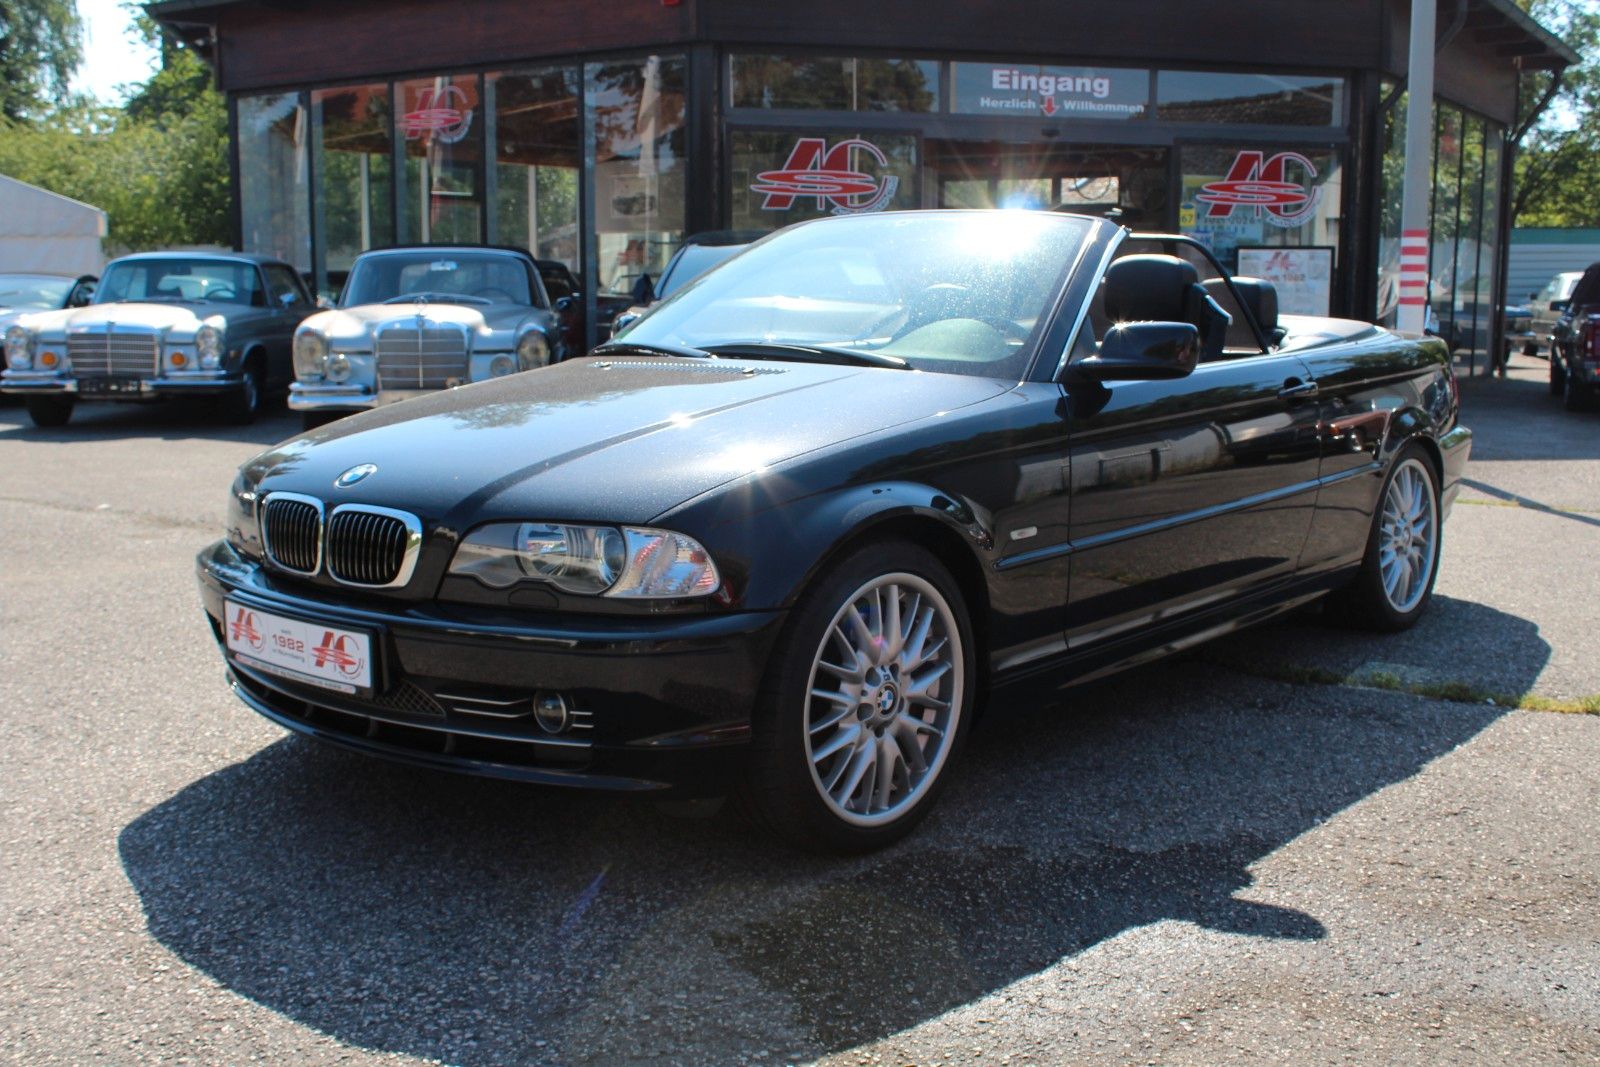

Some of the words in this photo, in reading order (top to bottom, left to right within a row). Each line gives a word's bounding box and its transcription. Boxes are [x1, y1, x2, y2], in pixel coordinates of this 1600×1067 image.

[992, 69, 1110, 98] Eingang
[980, 97, 1036, 109] Herzlich
[1063, 100, 1144, 113] Willkommen
[272, 633, 305, 653] 1982
